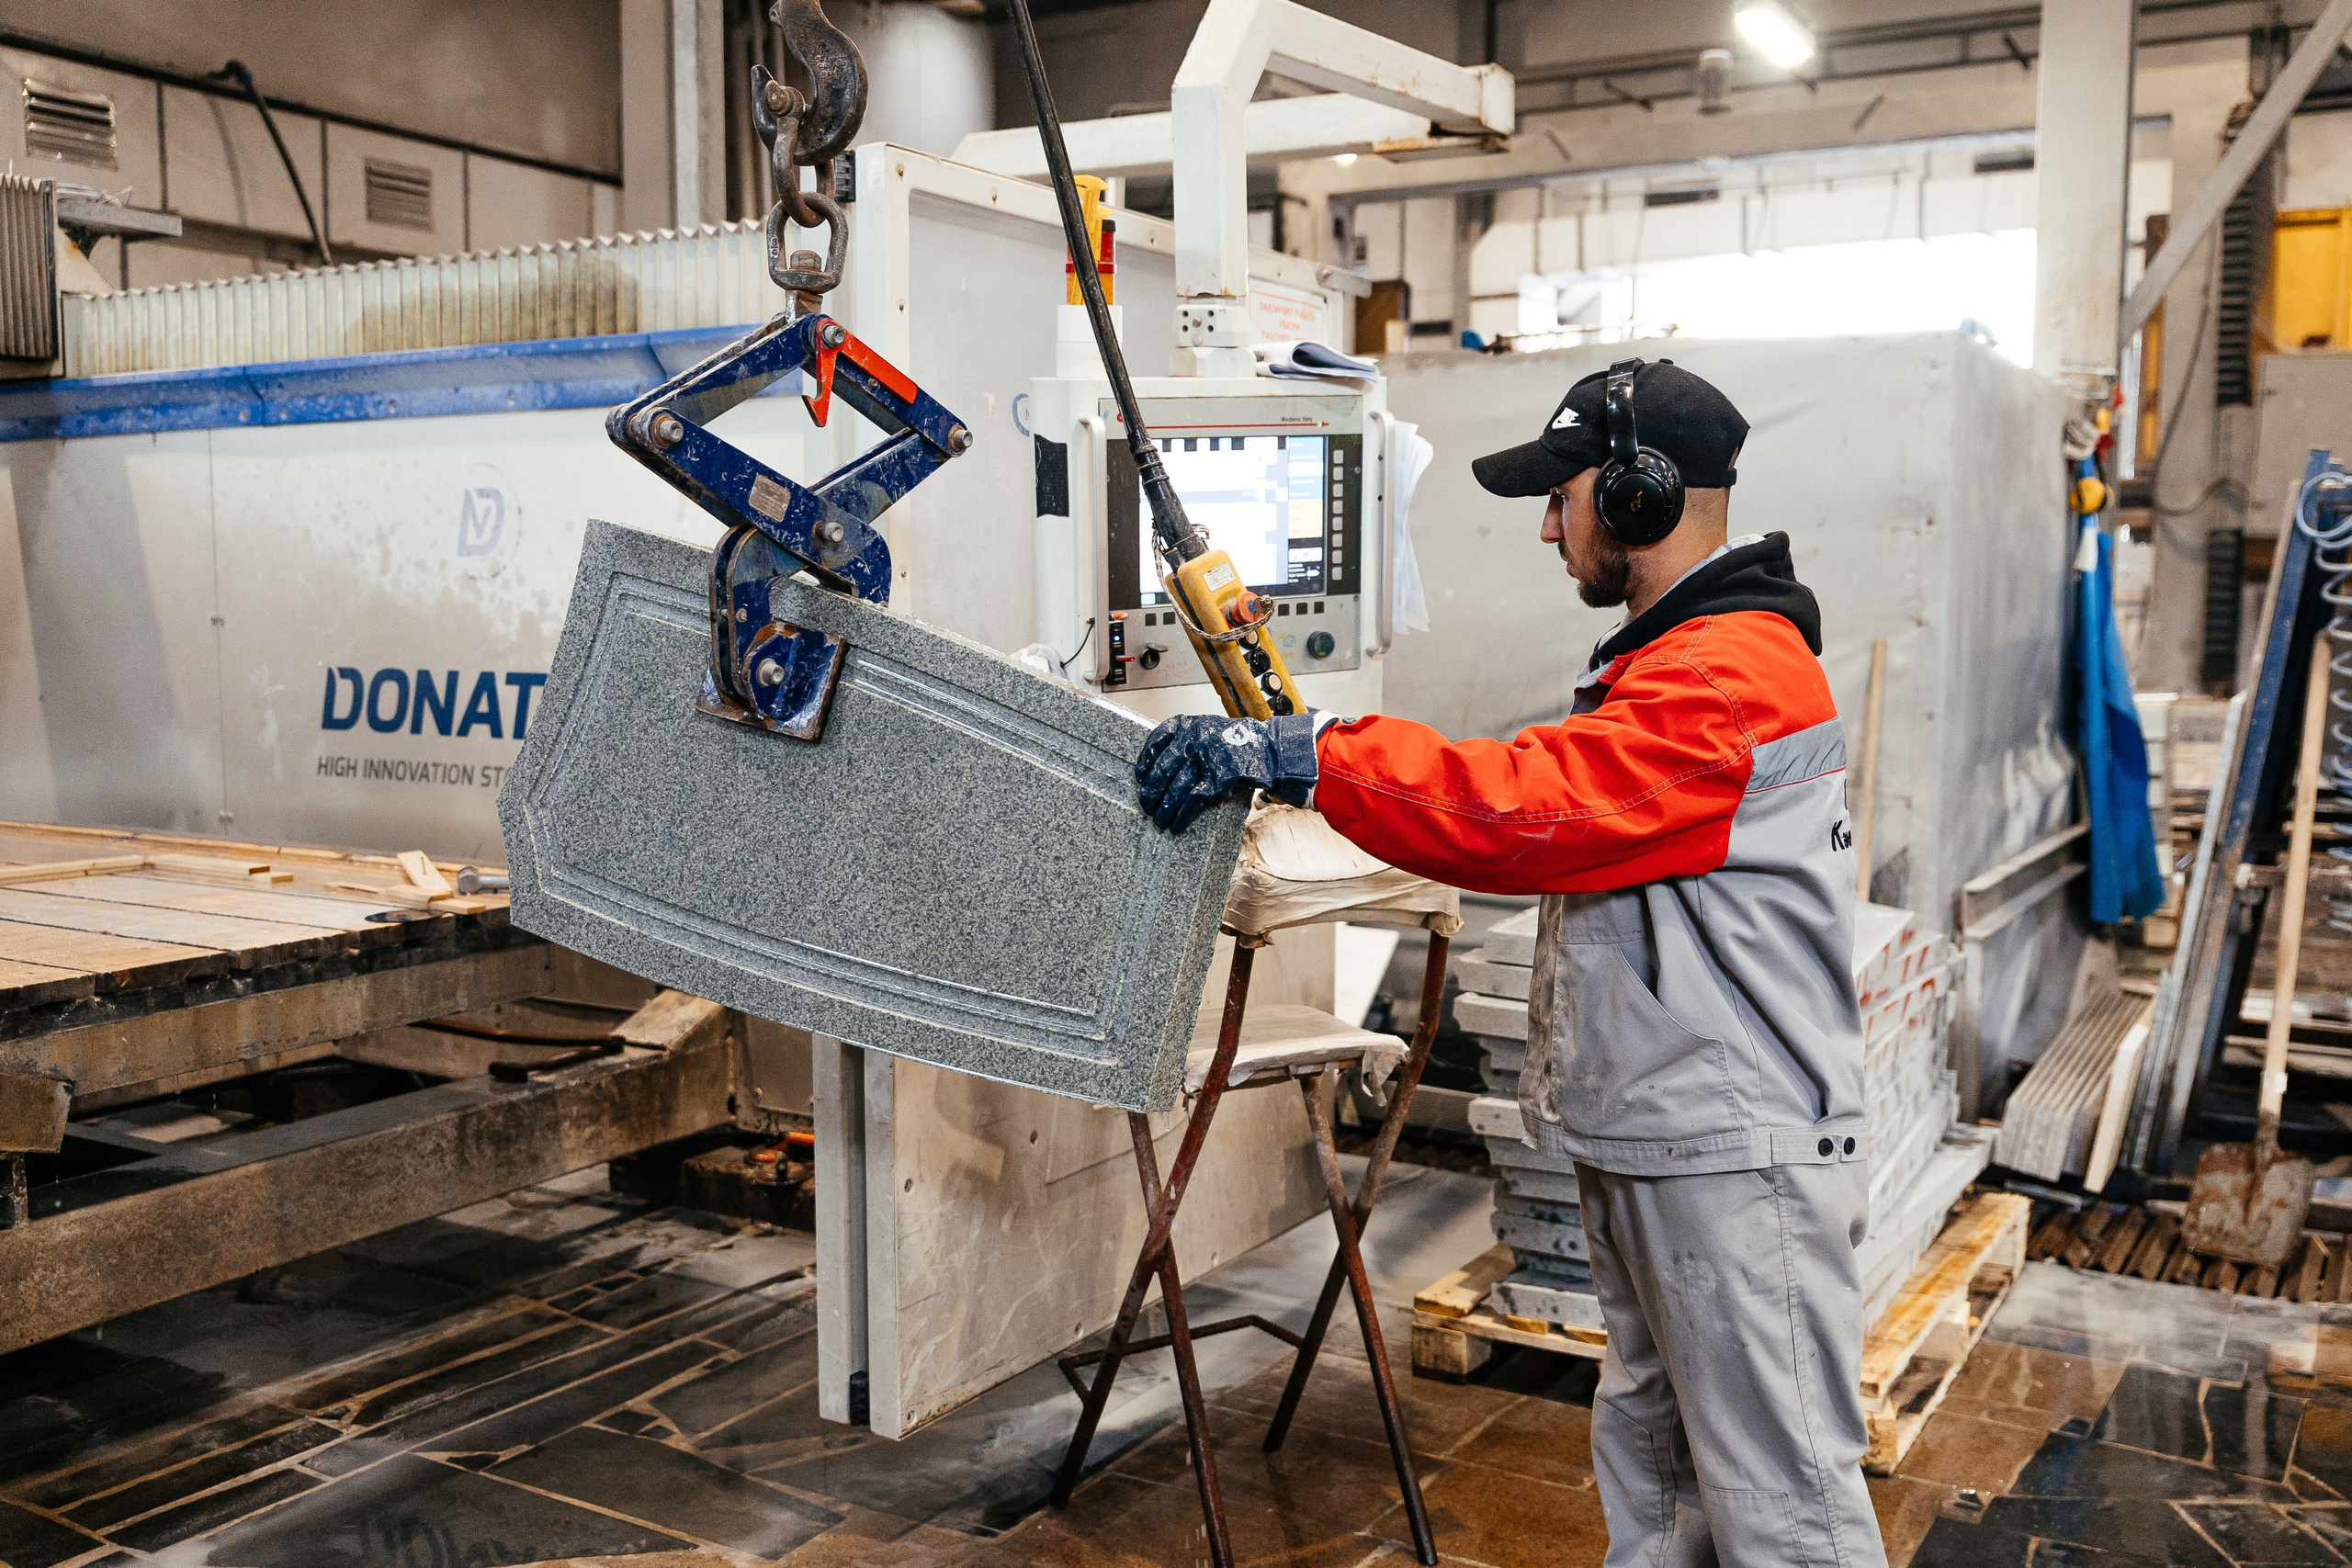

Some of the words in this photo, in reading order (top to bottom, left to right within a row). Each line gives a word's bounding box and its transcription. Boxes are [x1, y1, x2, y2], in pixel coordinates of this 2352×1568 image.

[317, 756, 357, 778] HIGH
[363, 759, 475, 787] INNOVATION
[481, 765, 512, 787] ST
